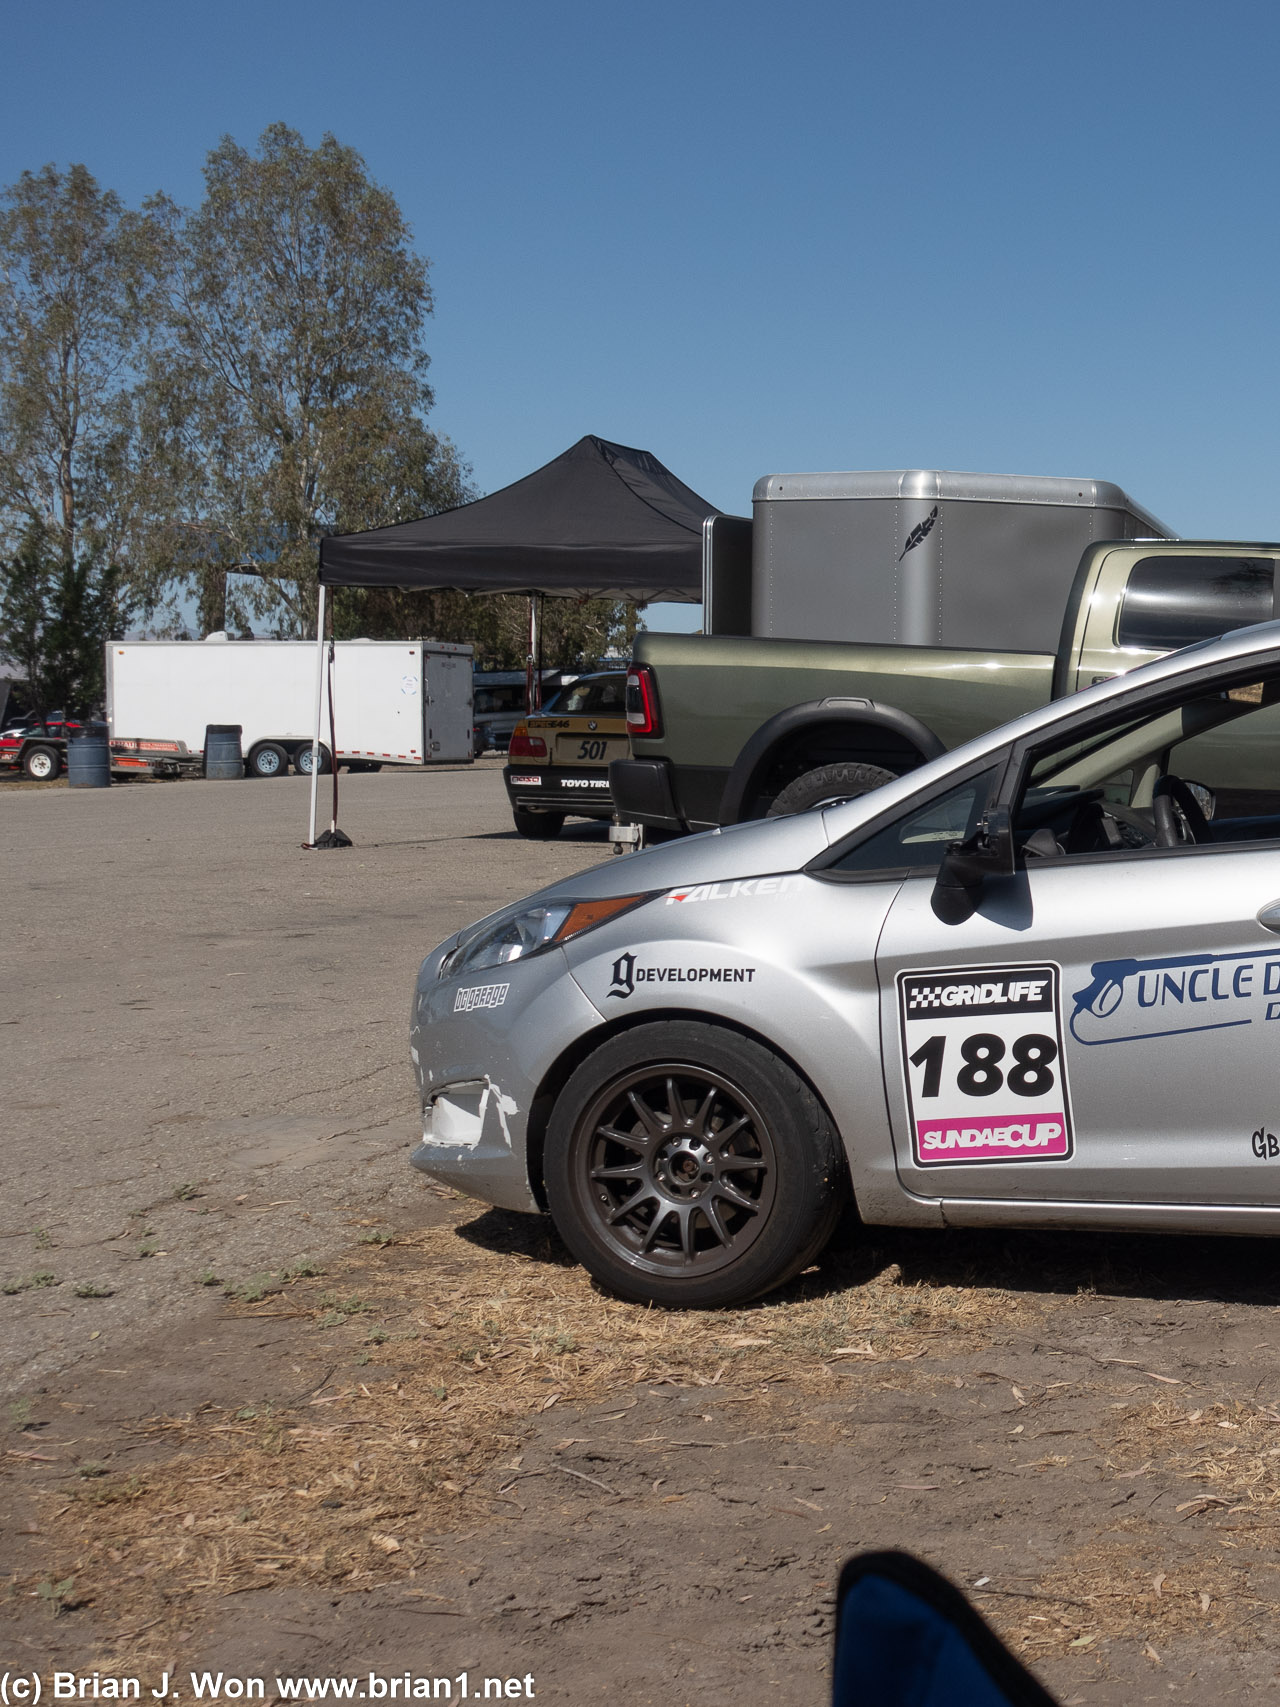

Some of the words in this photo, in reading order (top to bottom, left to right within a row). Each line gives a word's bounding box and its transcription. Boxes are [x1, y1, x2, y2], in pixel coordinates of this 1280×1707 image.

[577, 741, 608, 760] 501
[561, 779, 589, 788] TOYO
[635, 967, 757, 983] DEVELOPMENT
[1137, 963, 1255, 1008] UNCLE
[940, 980, 1049, 1008] GRIDLIFE
[908, 1032, 1059, 1098] 188
[1251, 1126, 1280, 1160] GB
